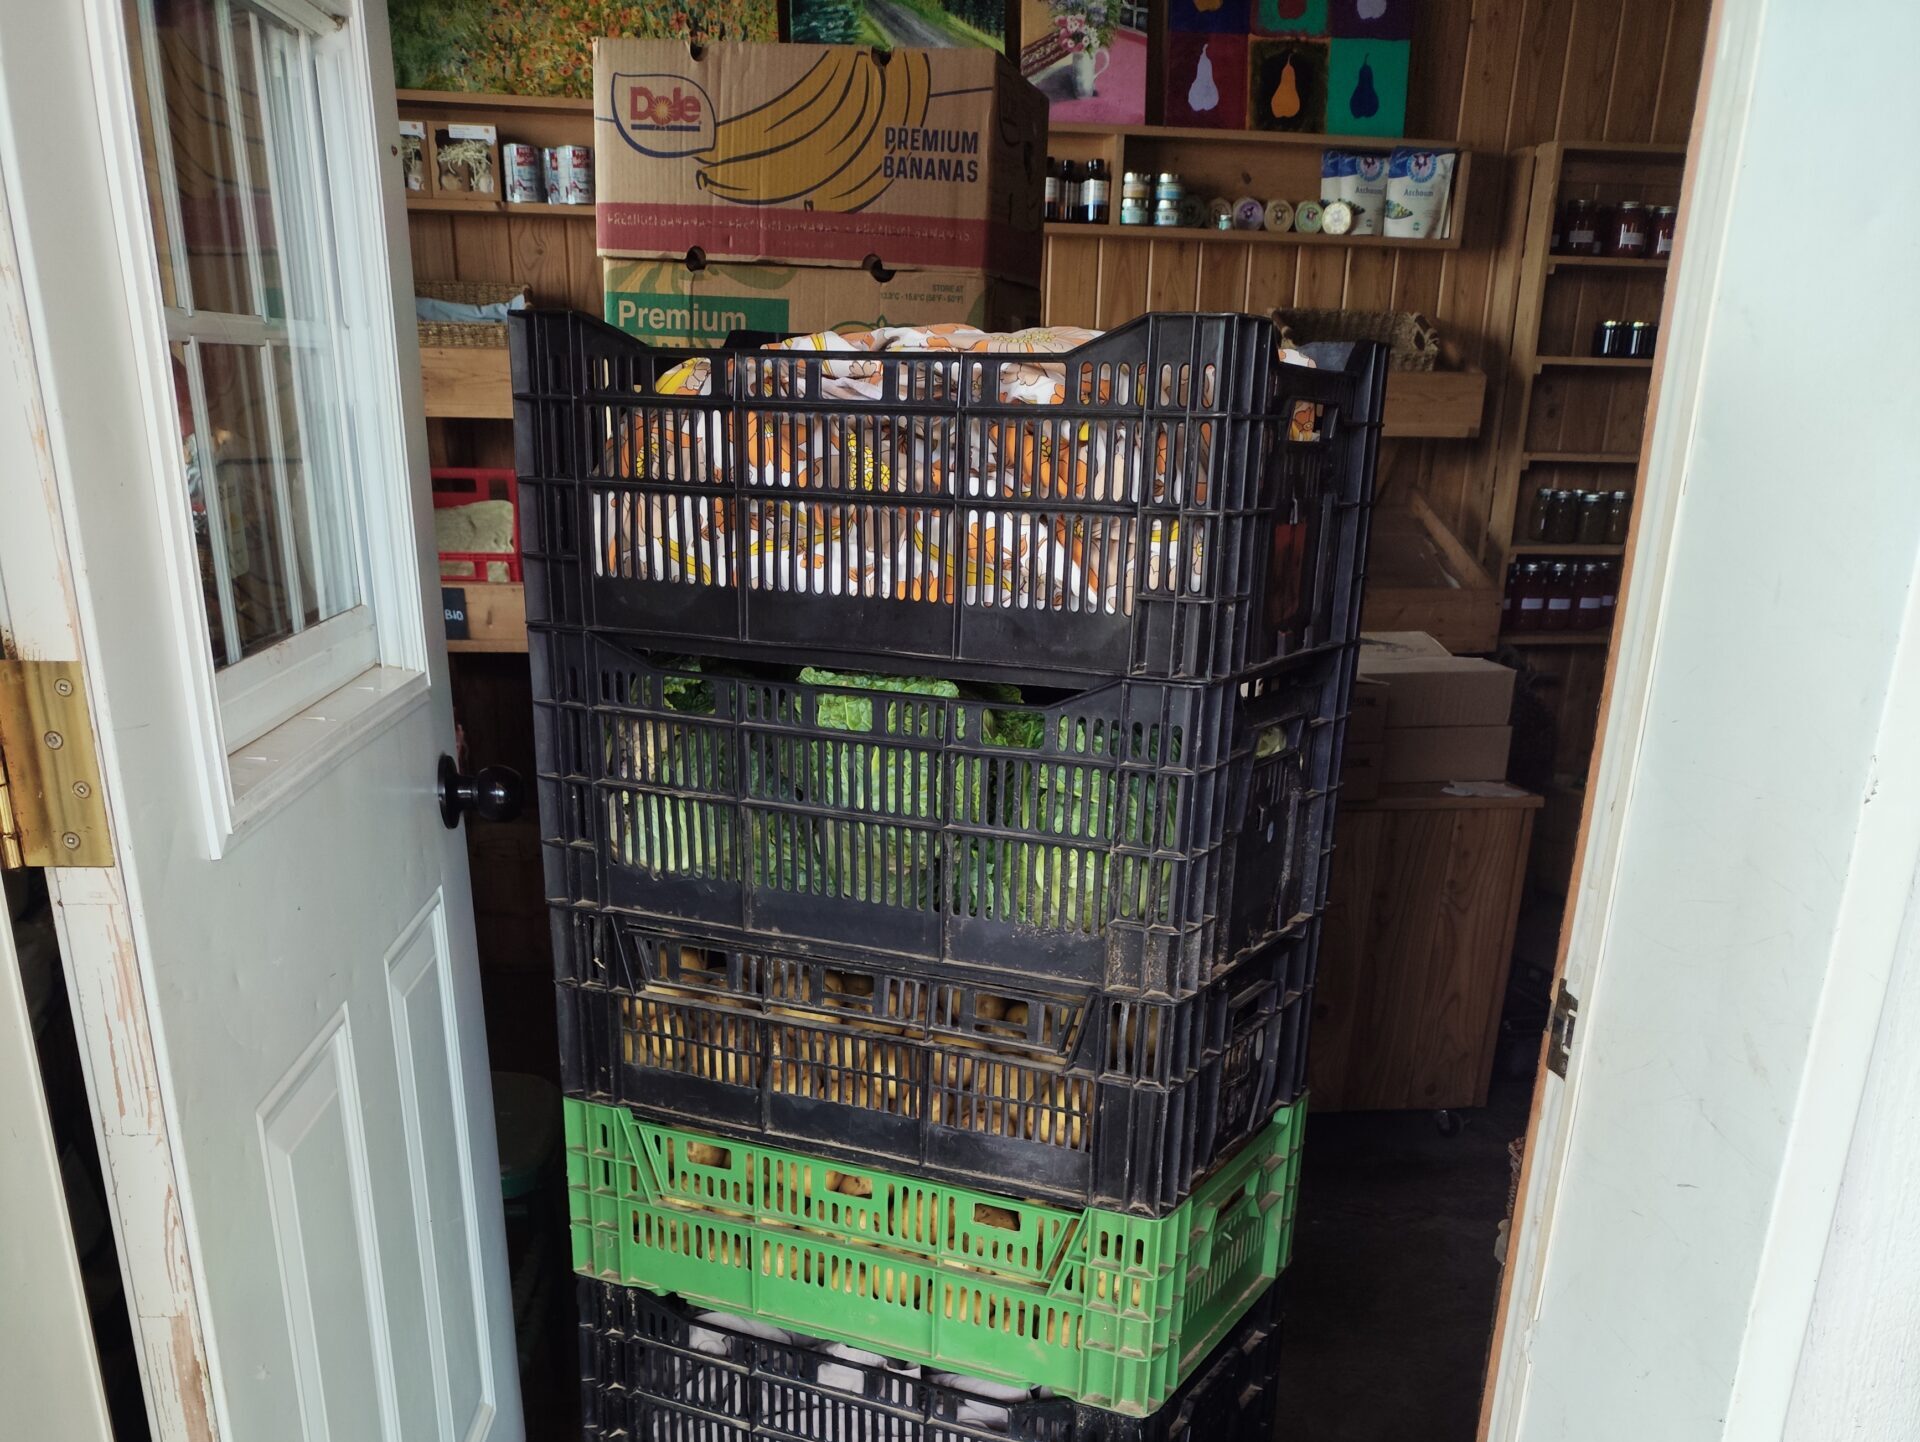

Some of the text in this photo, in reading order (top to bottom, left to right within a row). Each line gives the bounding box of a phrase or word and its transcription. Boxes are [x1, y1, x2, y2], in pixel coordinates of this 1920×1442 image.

[630, 85, 702, 125] Dole
[884, 126, 979, 154] PREMIUM
[883, 155, 978, 183] BANANAS
[617, 299, 748, 332] Premium
